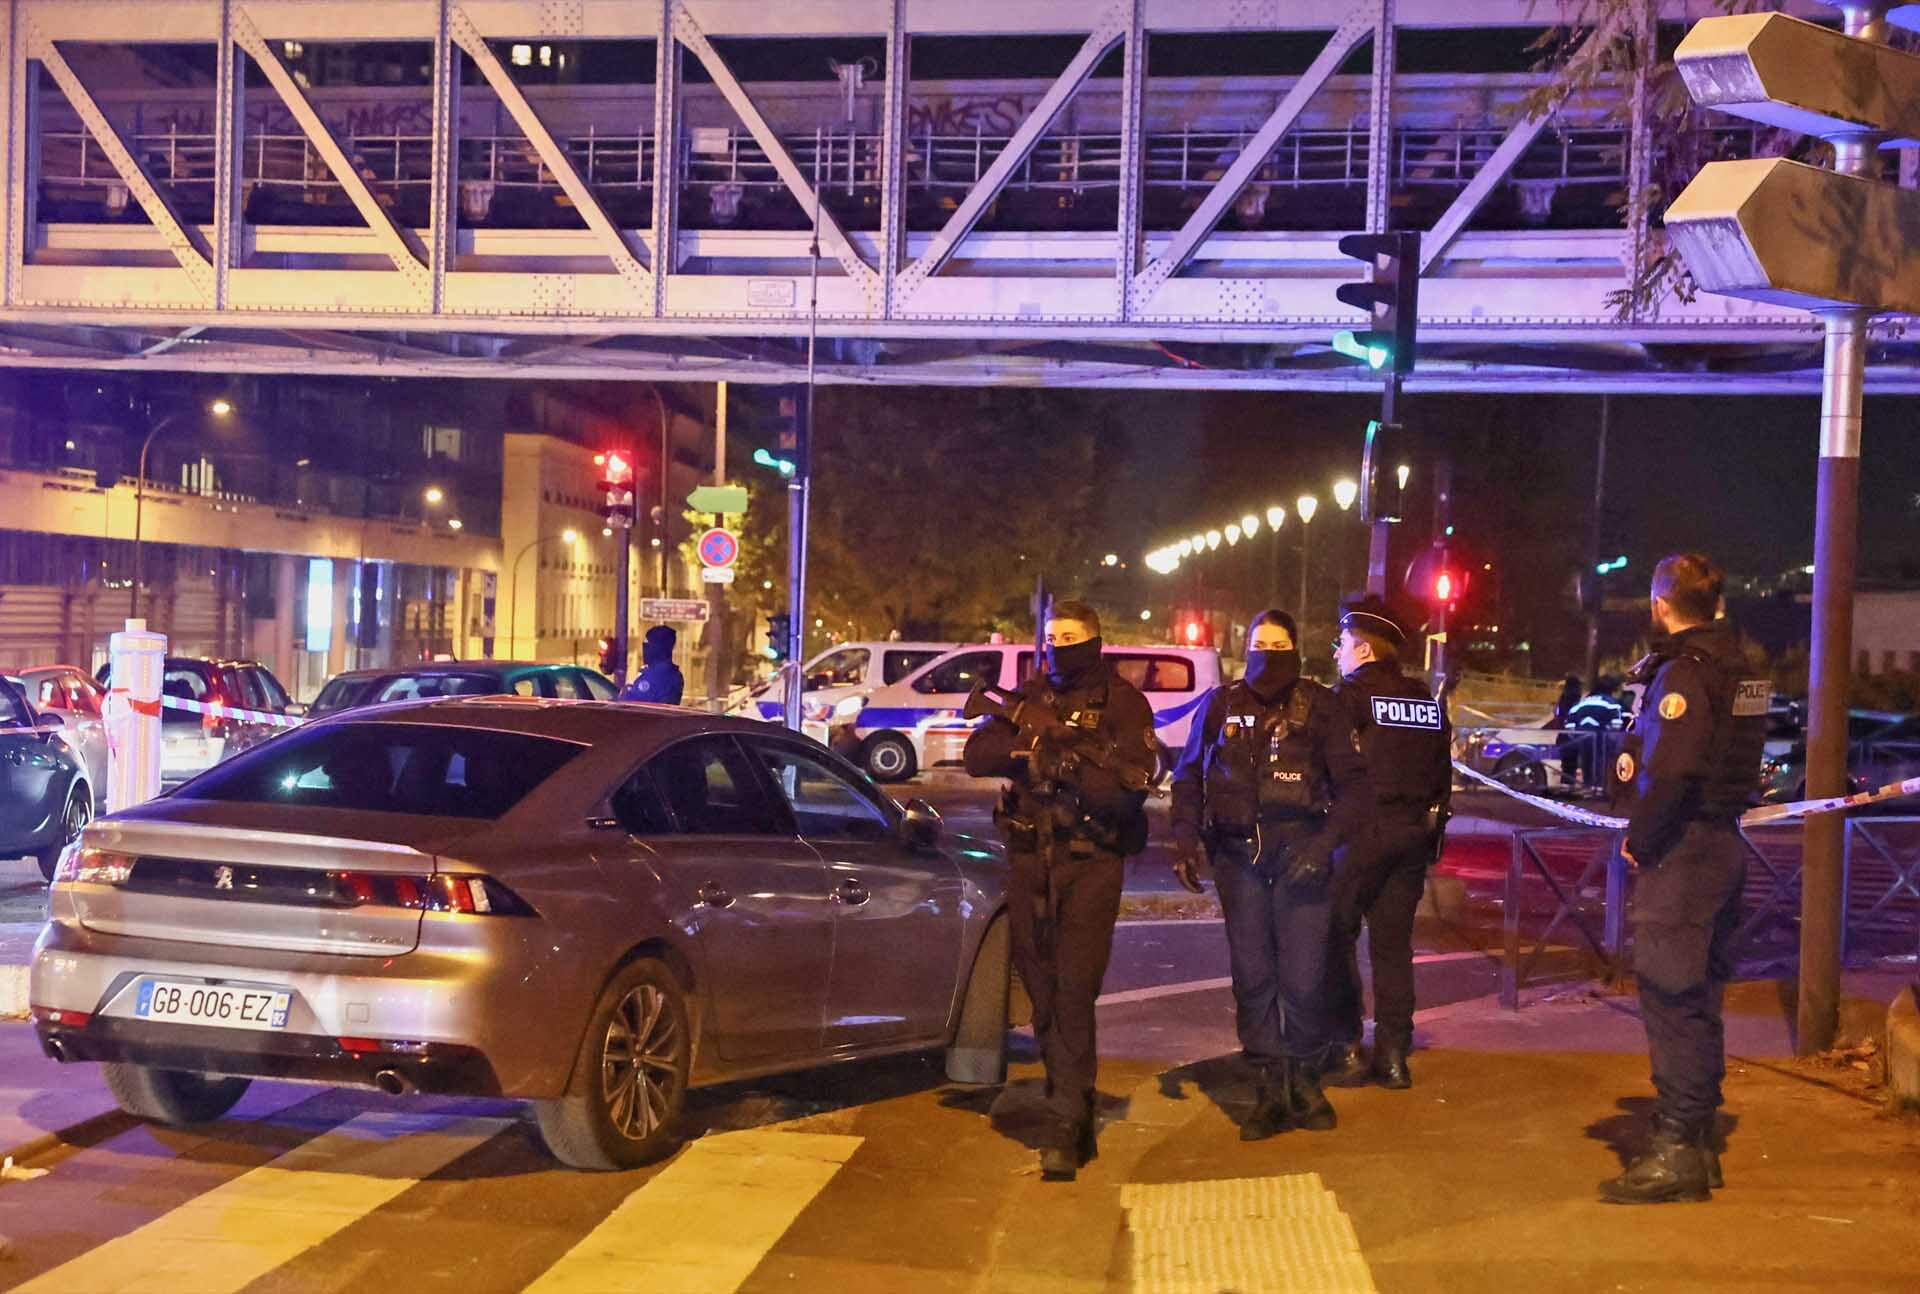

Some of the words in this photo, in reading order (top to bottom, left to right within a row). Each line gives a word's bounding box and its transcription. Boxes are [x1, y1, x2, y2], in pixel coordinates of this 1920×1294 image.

[1375, 701, 1438, 724] POLICE
[1273, 771, 1302, 781] POLICE
[153, 987, 273, 1022] GB-006-EZ
